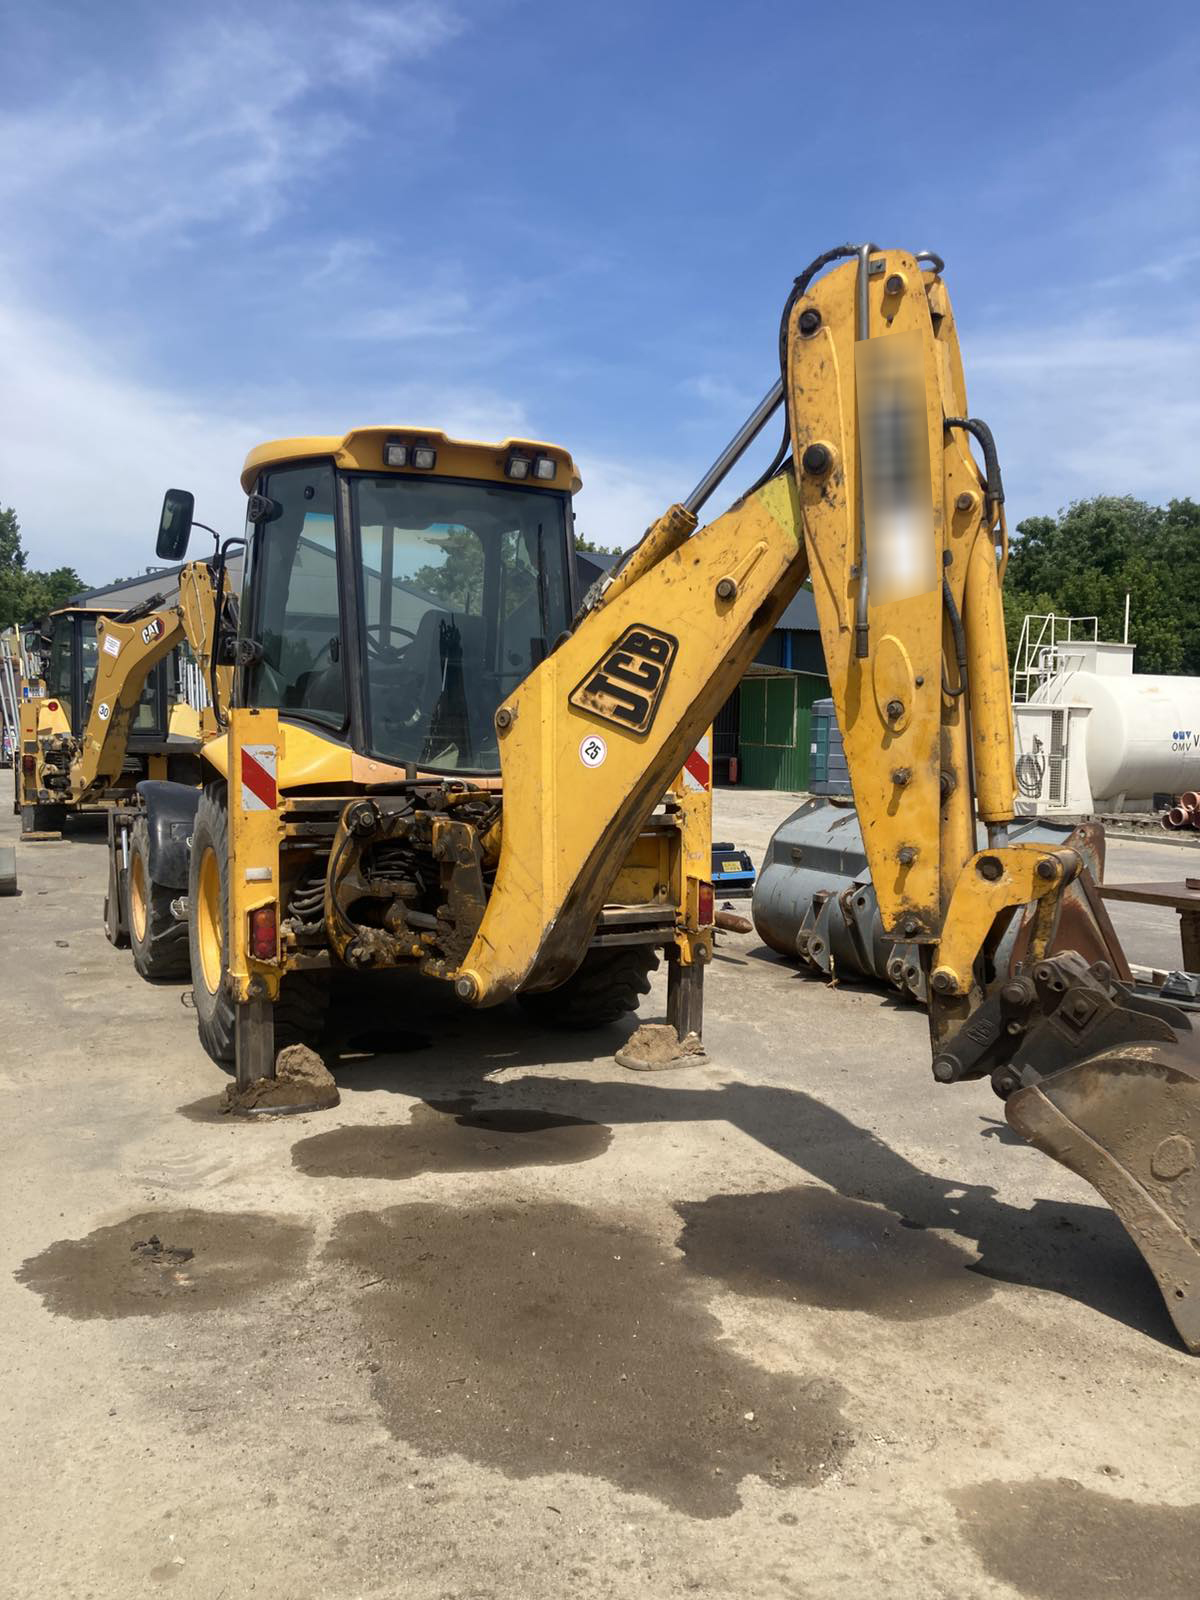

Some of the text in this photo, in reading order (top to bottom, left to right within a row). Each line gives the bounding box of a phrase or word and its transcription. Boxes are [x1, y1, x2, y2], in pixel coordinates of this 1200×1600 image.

[141, 617, 160, 645] CAT
[584, 631, 671, 724] JCB
[585, 741, 602, 760] 25
[1171, 742, 1192, 752] OMV
